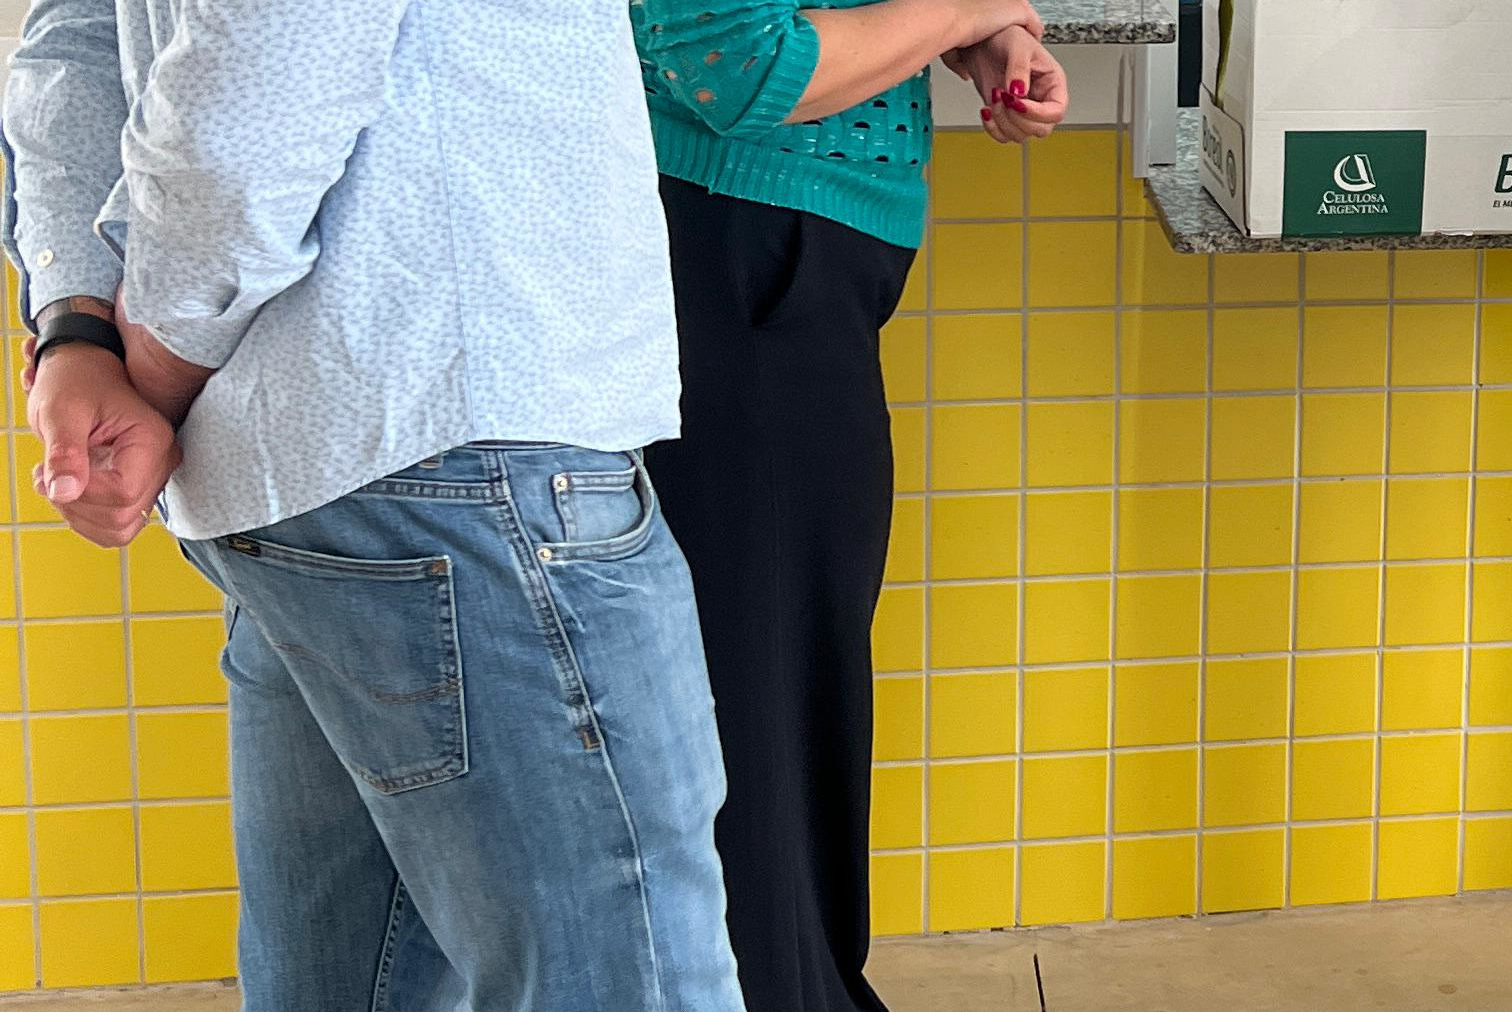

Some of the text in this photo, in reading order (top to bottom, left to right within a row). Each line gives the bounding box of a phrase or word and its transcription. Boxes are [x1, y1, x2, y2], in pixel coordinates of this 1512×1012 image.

[1323, 191, 1385, 204] CELULOSA
[1493, 200, 1501, 208] EL
[1317, 202, 1389, 215] ARGENTINA
